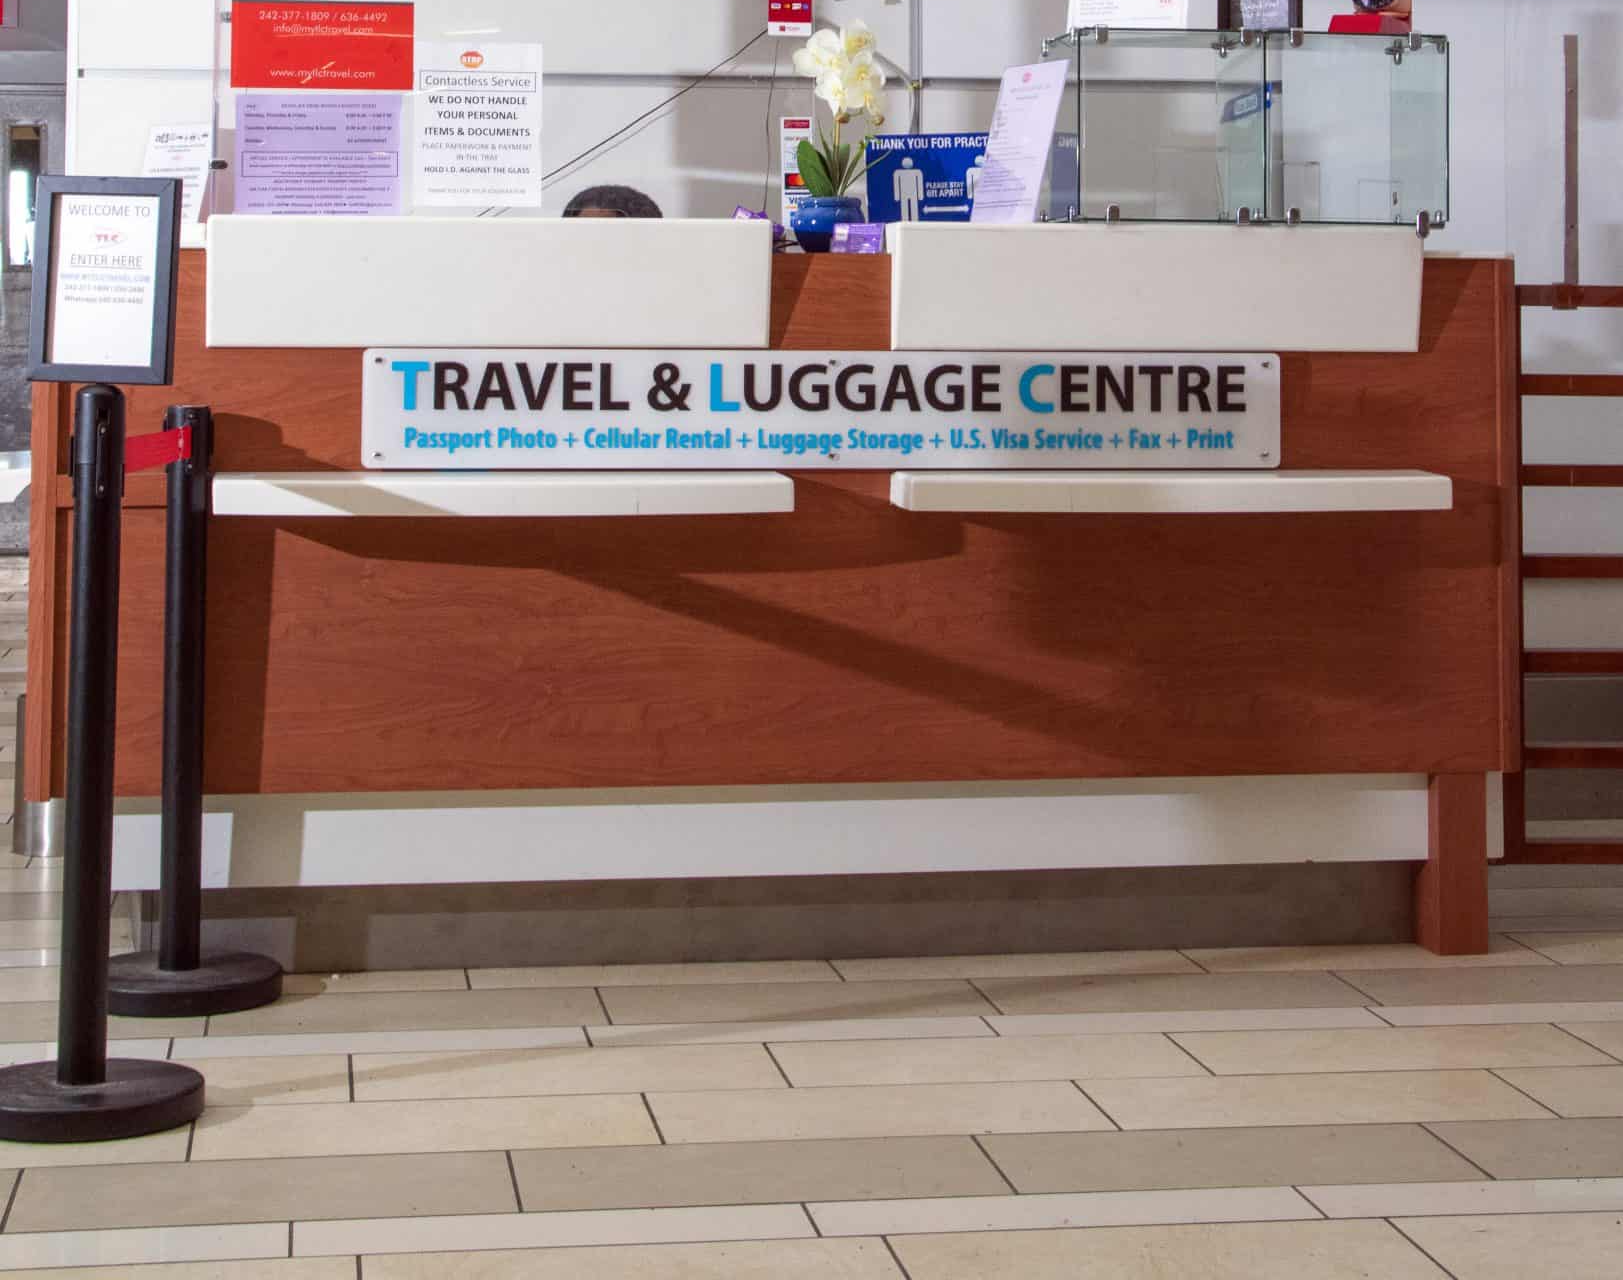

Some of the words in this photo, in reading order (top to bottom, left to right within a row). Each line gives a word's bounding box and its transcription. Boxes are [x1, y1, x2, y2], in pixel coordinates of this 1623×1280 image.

[424, 74, 488, 87] Contactless
[491, 76, 531, 88] Service
[428, 95, 444, 105] WE
[447, 96, 462, 105] DO
[464, 96, 485, 105] NOT
[488, 96, 528, 106] HANDLE
[437, 110, 465, 119] YOUR
[467, 111, 518, 121] PERSONAL
[424, 127, 455, 136] ITEMS
[456, 127, 465, 136] &
[467, 127, 531, 137] DOCUMENTS
[870, 138, 906, 151] THANK
[907, 137, 929, 150] YOU
[931, 136, 952, 149] FOR
[954, 136, 991, 148] PRACT
[424, 166, 445, 174] HOLD
[459, 166, 491, 174] AGAINST
[68, 204, 131, 217] WELCOME
[135, 205, 151, 218] TO
[70, 254, 108, 266] ENTER
[111, 255, 143, 267] HERE
[391, 361, 630, 411] TRAVEL
[647, 362, 691, 412] &
[709, 362, 1001, 413] LUGGAGE
[1018, 364, 1247, 414] CENTRE
[404, 427, 492, 453] Passport
[500, 427, 558, 449] Photo
[584, 427, 661, 450] Cellular
[666, 428, 731, 450] Rental
[758, 428, 842, 454] Luggage
[847, 428, 924, 454] Storage
[950, 429, 986, 450] U.S.
[992, 429, 1029, 450] Visa
[1035, 429, 1103, 450] Service
[1129, 429, 1161, 450] Fax
[1187, 429, 1234, 450] Print
